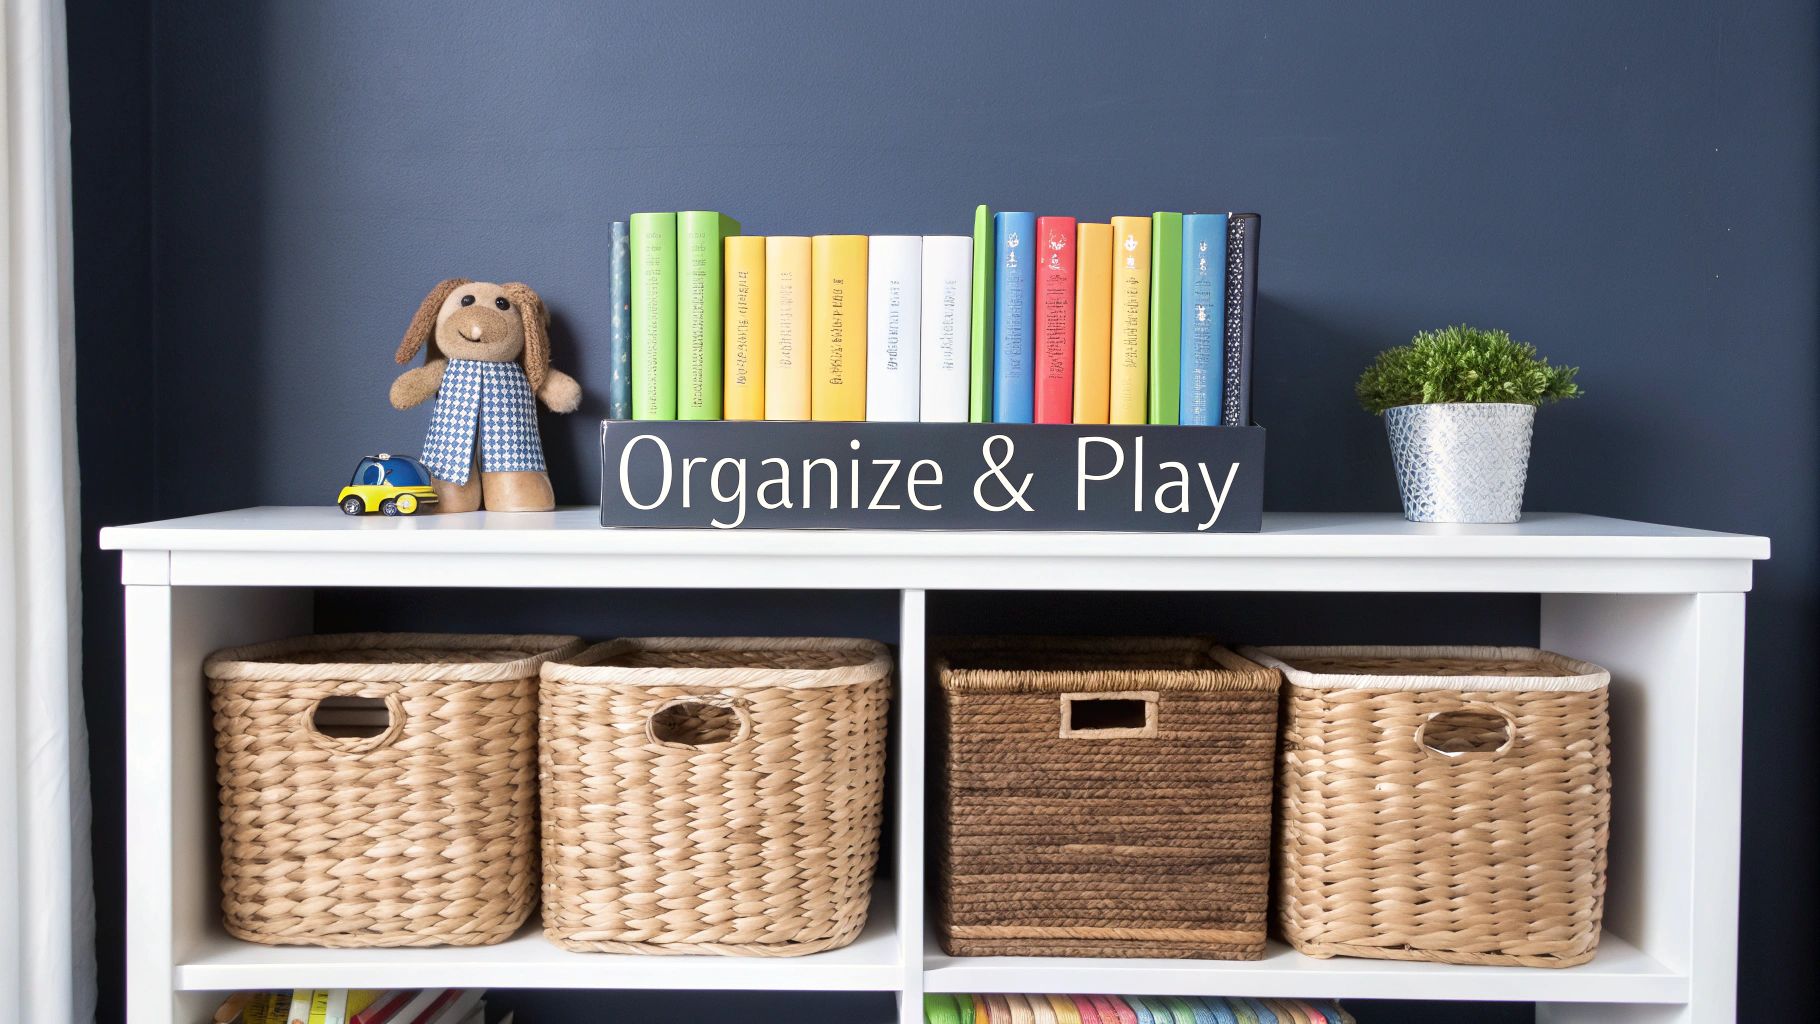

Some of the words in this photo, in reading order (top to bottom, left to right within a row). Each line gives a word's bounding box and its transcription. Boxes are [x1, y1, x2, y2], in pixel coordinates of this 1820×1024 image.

[619, 435, 944, 529] Organize
[973, 434, 1036, 512] &
[1077, 436, 1241, 530] Play
